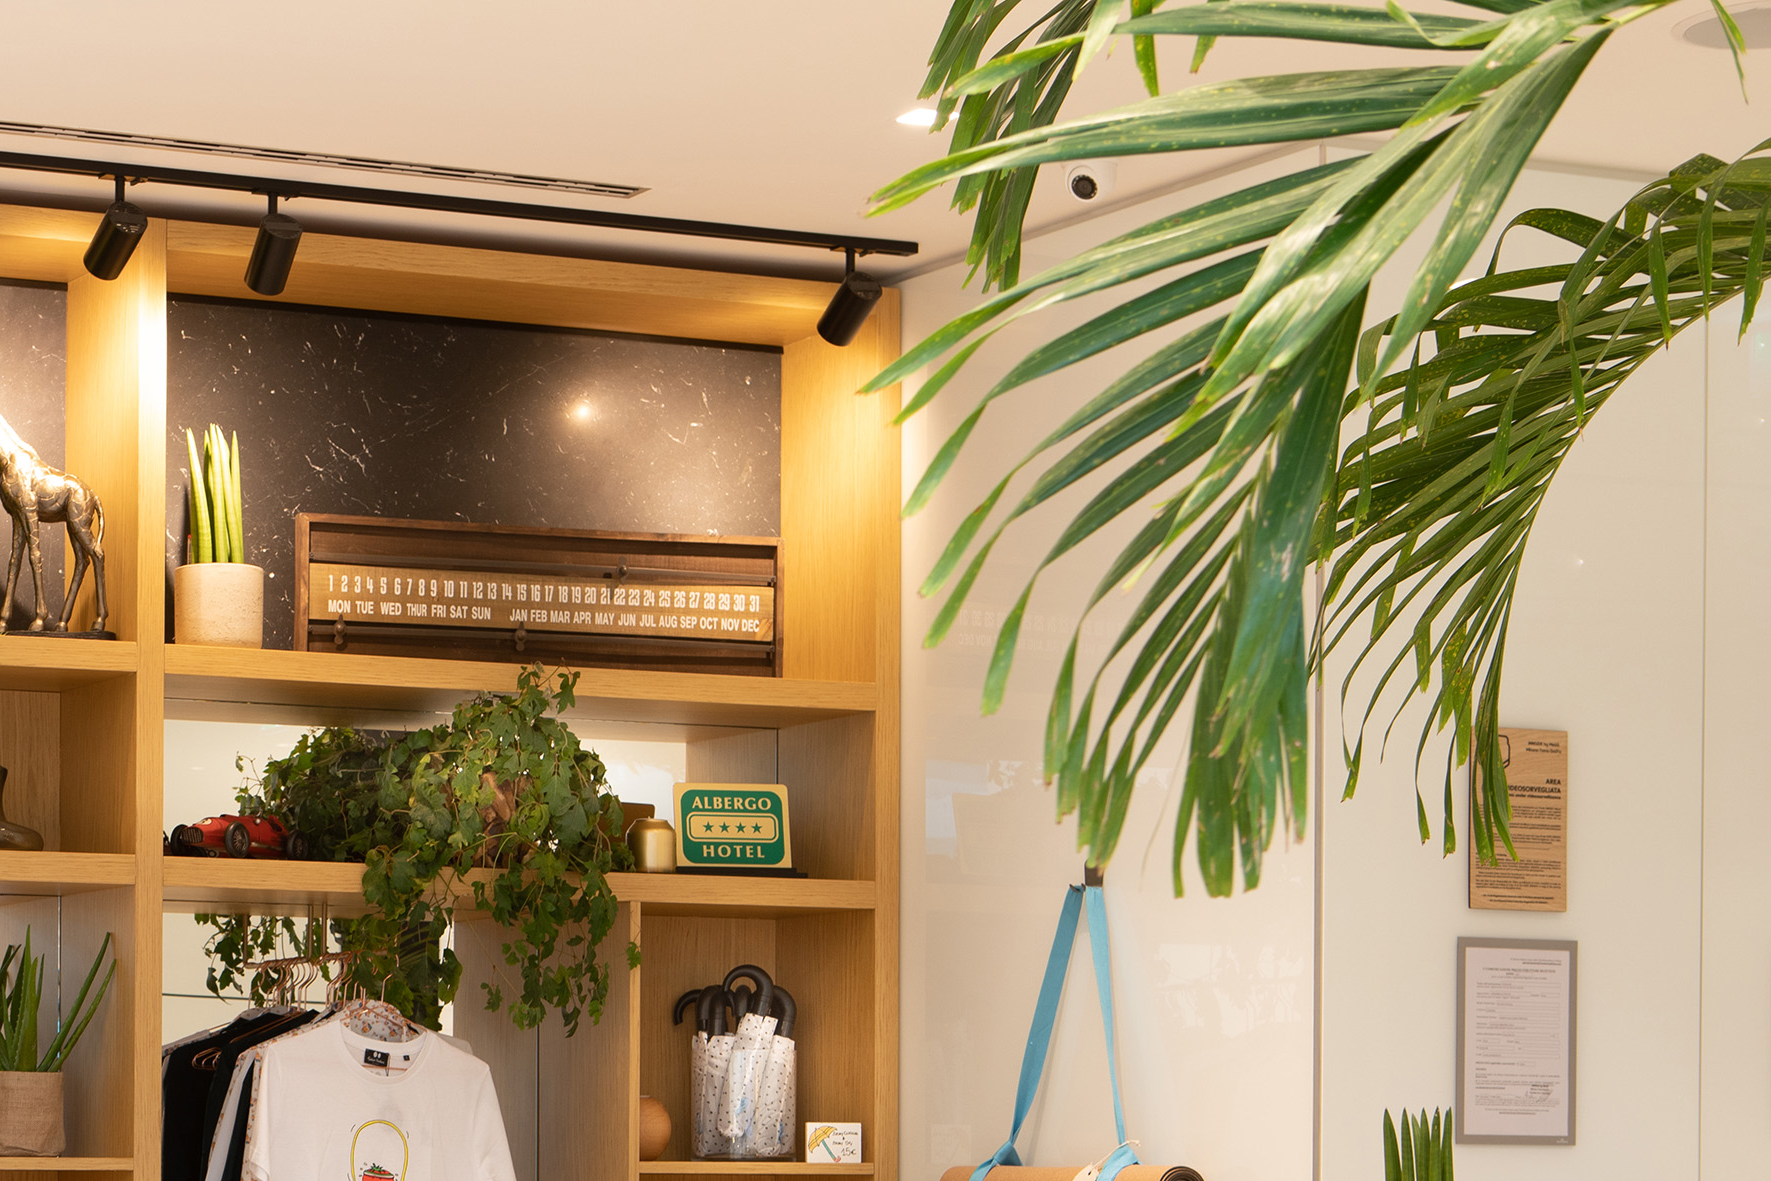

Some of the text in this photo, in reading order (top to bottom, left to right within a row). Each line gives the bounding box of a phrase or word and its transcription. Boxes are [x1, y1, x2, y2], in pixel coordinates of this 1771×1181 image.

[328, 574, 760, 612] 1 2 3 4 5 6 7 8 9 10 11 12 13 14 15 16 17 18 19 20 21 22 23 24 25 26 27 28 29 30 31
[328, 599, 760, 633] MON TUE WED THUR FRI SAT SUN JAN FEB MAR APR MAY JUN JUL AUG SEP OCT NOV DEC
[1508, 785, 1561, 794] IDEOSORVEGLIATA
[691, 796, 772, 811] ALBERGO
[702, 844, 766, 859] HOTEL
